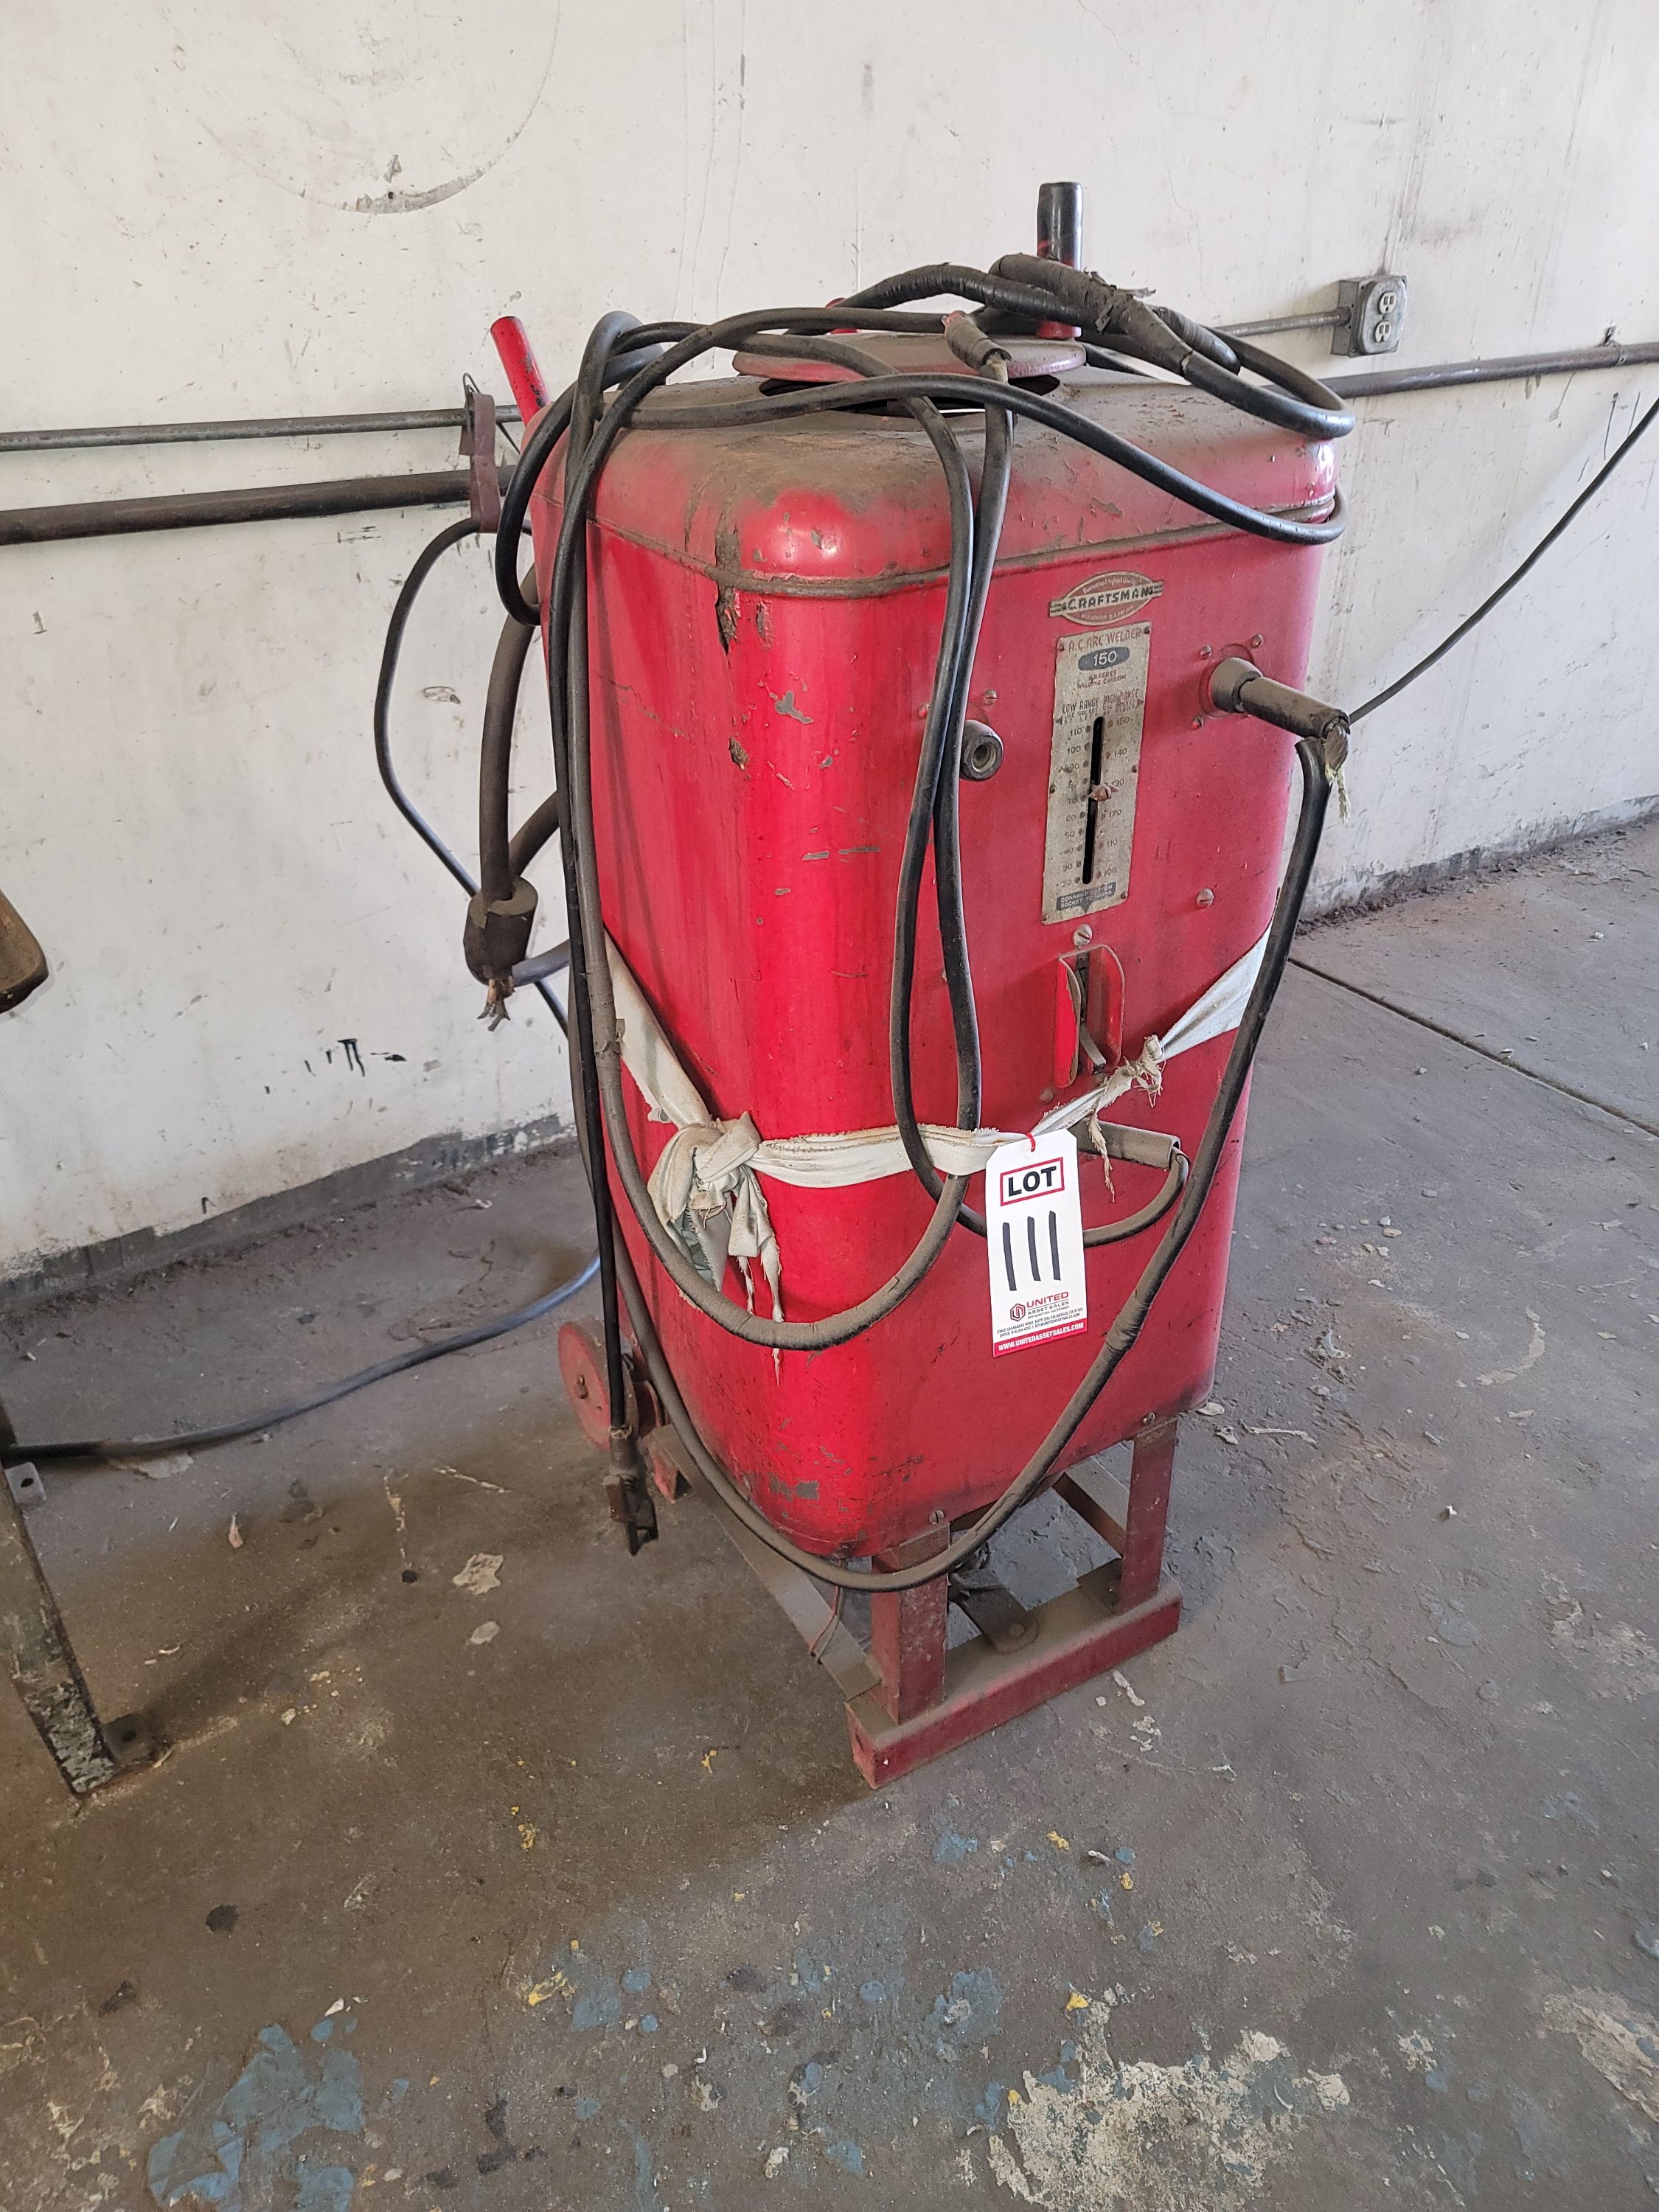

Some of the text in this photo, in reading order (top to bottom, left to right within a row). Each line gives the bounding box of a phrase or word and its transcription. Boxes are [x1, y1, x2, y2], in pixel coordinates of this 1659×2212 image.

[1067, 586, 1151, 611] CRAFTSMAN
[1086, 635, 1104, 650] ARC
[1107, 627, 1141, 645] WELDER
[1093, 650, 1118, 667] 150
[1062, 697, 1100, 714] LOW RANGE
[1116, 716, 1130, 726] 150
[1069, 727, 1082, 737] 110
[1068, 746, 1082, 755] 100
[1114, 748, 1127, 757] 140
[1107, 838, 1118, 848] 110
[1008, 1166, 1057, 1197] LOT
[1003, 1210, 1062, 1291] 111
[1026, 1291, 1069, 1308] UNITED
[1027, 1301, 1069, 1315] ASSET SALES
[998, 1322, 1084, 1352] WWW.UNITEDASSETSALES.COM
